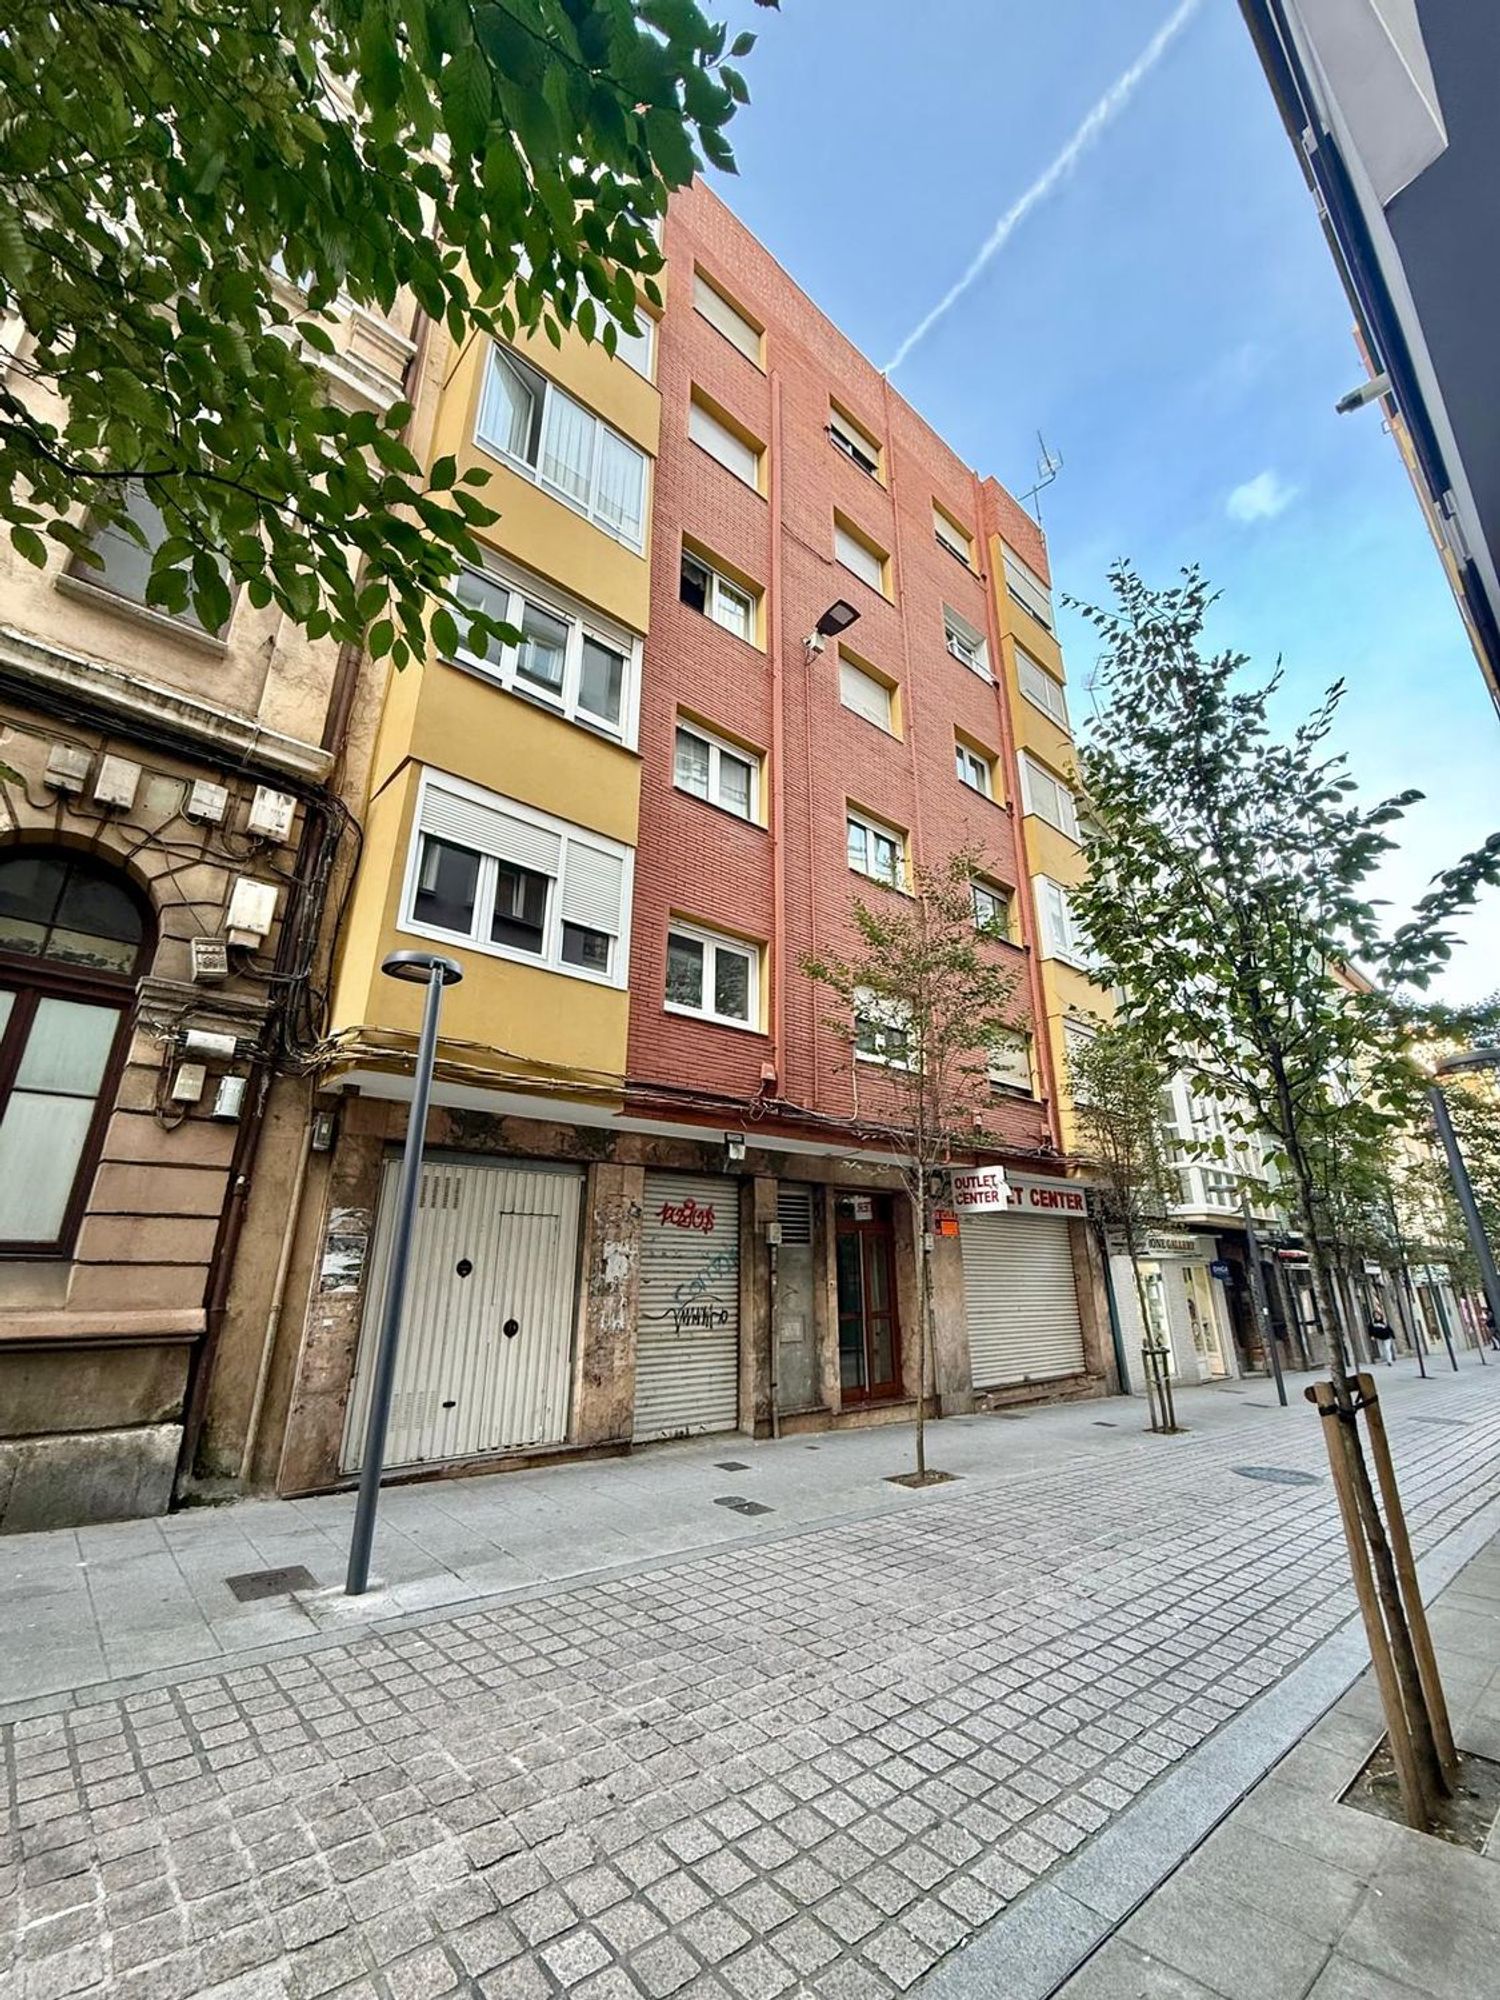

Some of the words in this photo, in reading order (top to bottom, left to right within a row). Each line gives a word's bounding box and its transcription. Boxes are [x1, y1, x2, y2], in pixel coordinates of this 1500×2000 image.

[954, 1174, 997, 1190] OUTLET
[955, 1190, 999, 1206] CENTER
[1030, 1188, 1084, 1211] CENTER
